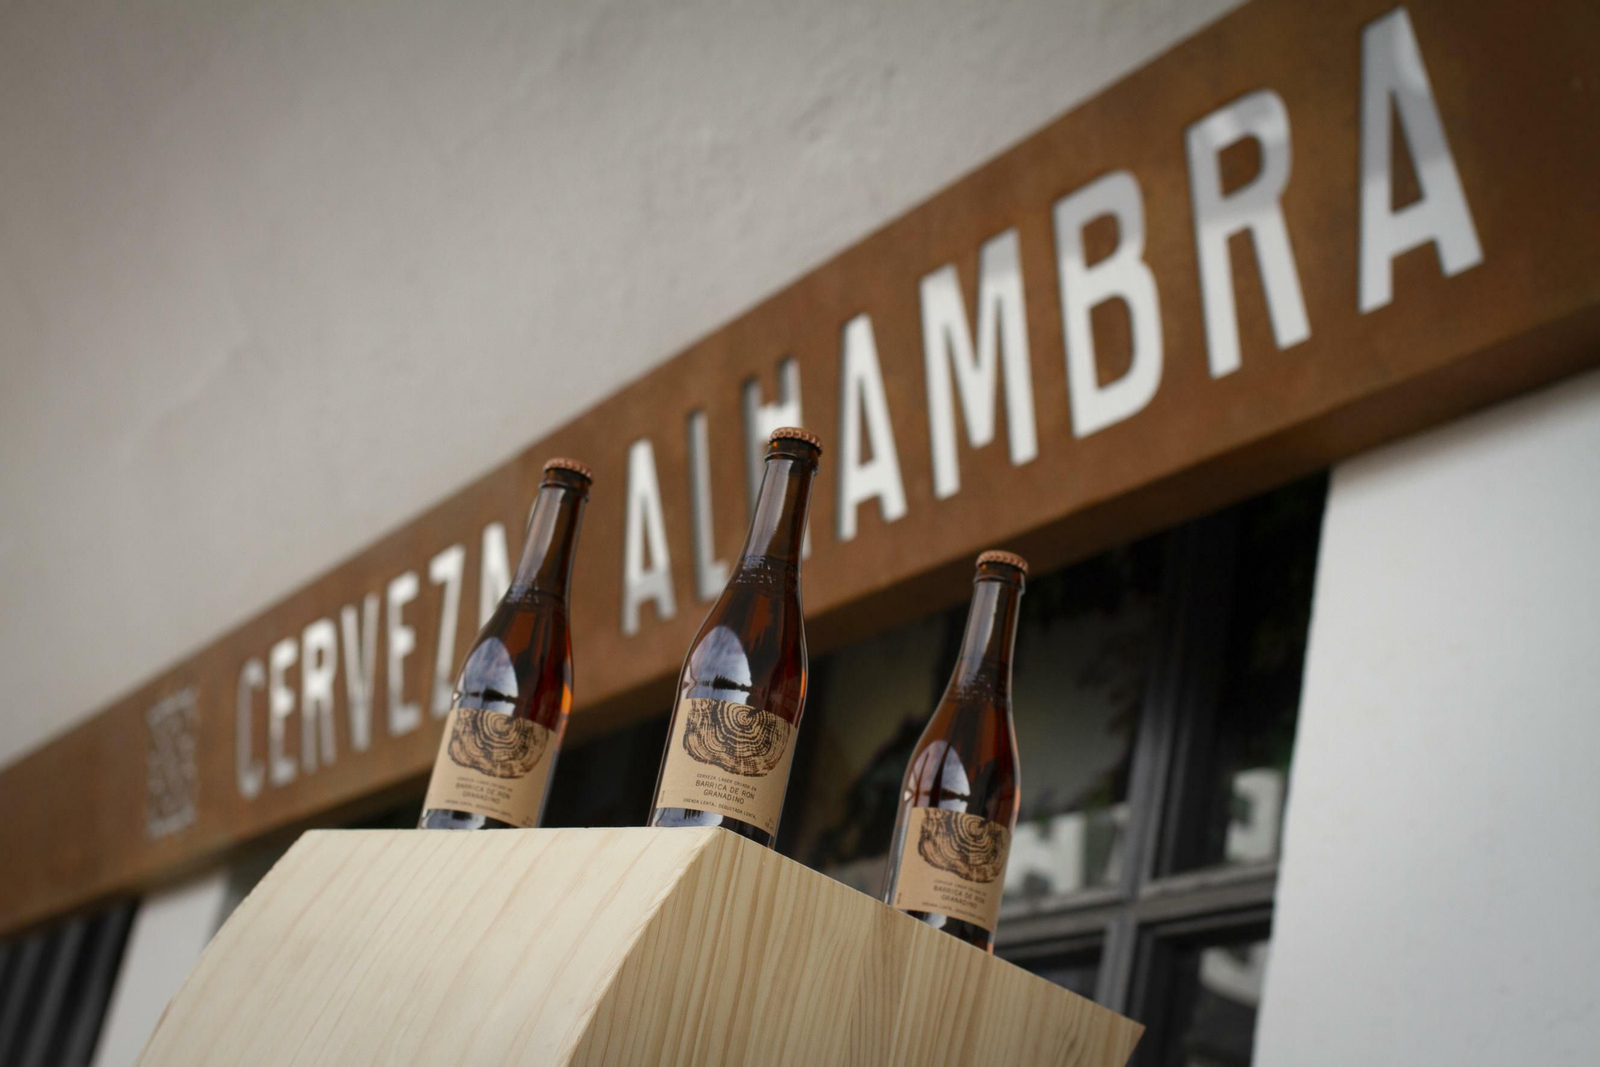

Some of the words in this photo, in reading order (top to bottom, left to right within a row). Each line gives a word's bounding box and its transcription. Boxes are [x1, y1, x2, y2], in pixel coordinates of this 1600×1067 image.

[622, 6, 1483, 636] ALHAMBRA
[695, 779, 727, 791] BARRICA
[730, 786, 739, 796] DE
[742, 790, 755, 800] RON
[703, 789, 745, 804] GRANADINO
